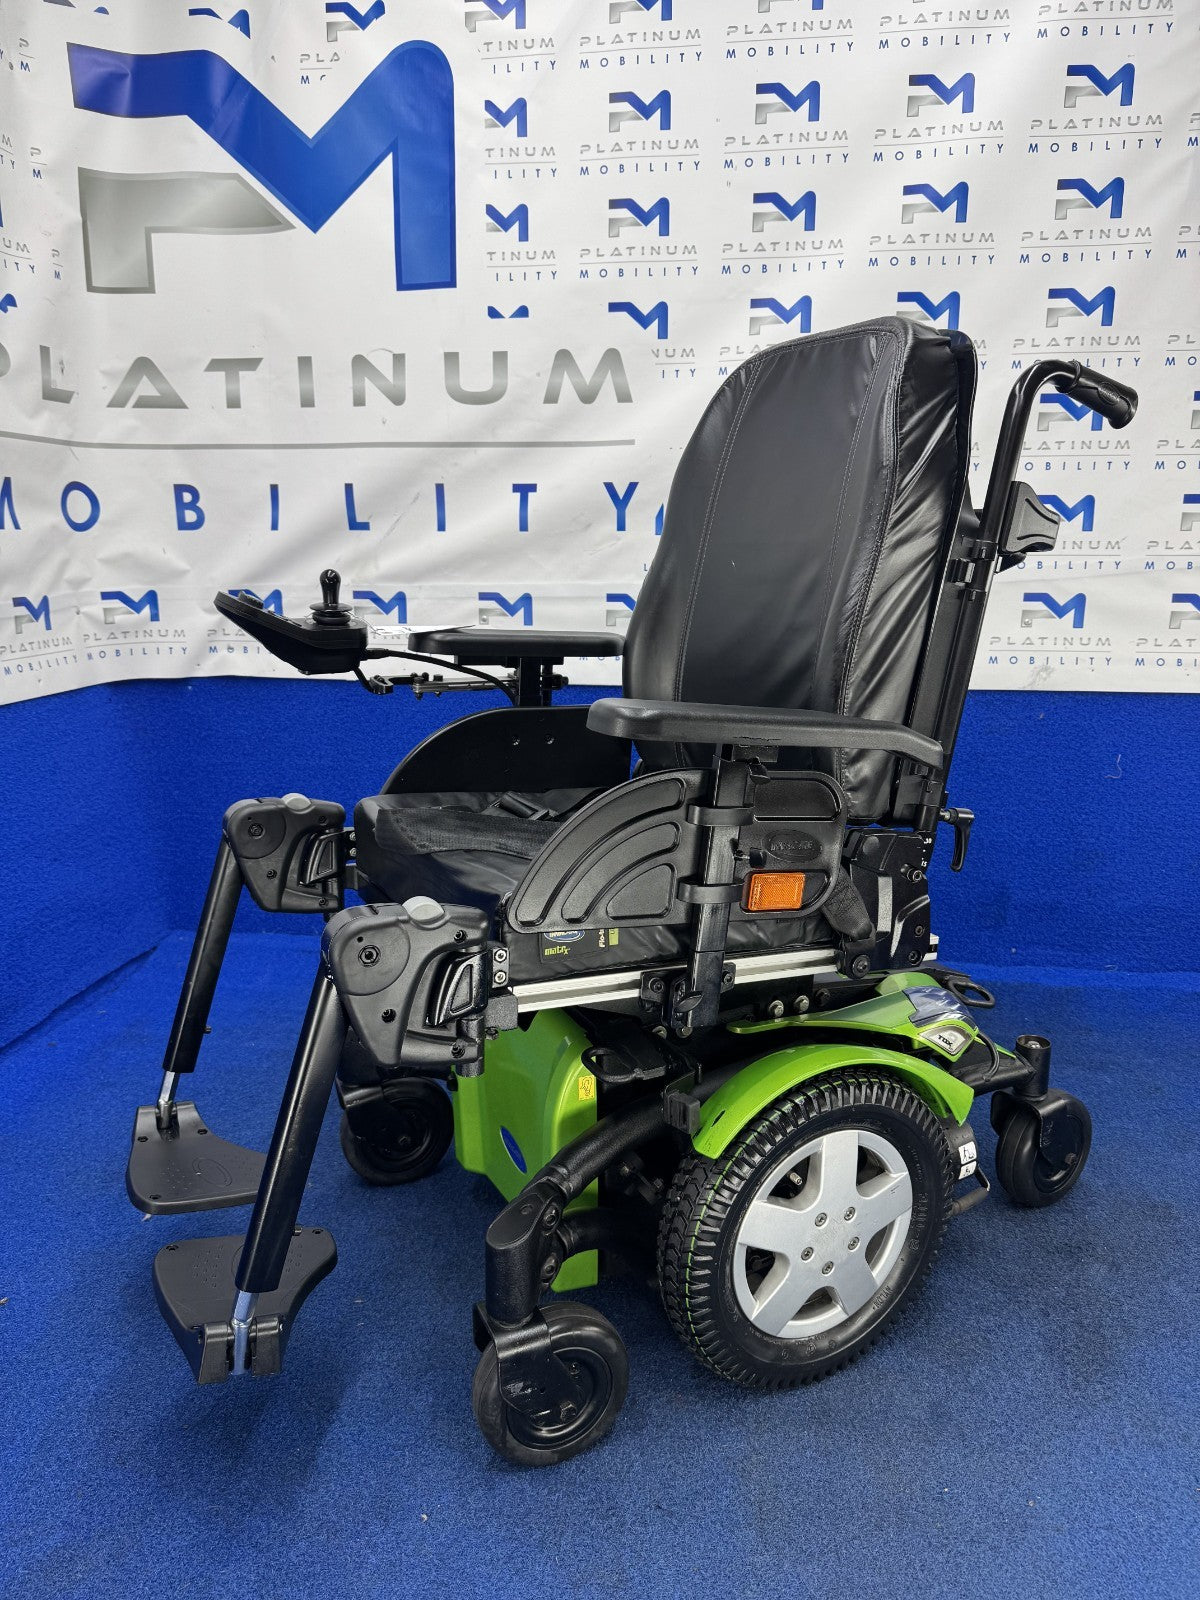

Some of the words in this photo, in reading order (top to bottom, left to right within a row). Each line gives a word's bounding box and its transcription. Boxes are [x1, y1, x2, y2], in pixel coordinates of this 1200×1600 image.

[1039, 0, 1175, 17] PLATINUM
[880, 9, 1010, 28] PLATINUM
[727, 19, 853, 38] PLATINUM
[1037, 21, 1174, 38] MOBILITY
[483, 37, 555, 54] TINUM
[580, 29, 701, 48] PLATINUM
[879, 31, 1010, 49] MOBILITY
[726, 41, 853, 58] MOBILITY
[491, 58, 556, 74] ILITY
[580, 51, 702, 69] MOBILITY
[874, 120, 1004, 141] PLATINUM
[1031, 115, 1163, 132] PLATINUM
[725, 130, 848, 148] PLATINUM
[1028, 138, 1162, 153] MOBILITY
[485, 147, 555, 158] TINUM
[580, 139, 699, 156] PLATINUM
[873, 142, 1003, 162] MOBILITY
[580, 160, 700, 176] MOBILITY
[724, 151, 849, 170] MOBILITY
[495, 168, 557, 179] ILITY
[870, 232, 994, 245] PLATINUM
[1022, 227, 1152, 243] PLATINUM
[580, 245, 697, 258] PLATINUM
[723, 239, 843, 255] PLATINUM
[487, 250, 555, 261] TINUM
[868, 255, 994, 267] MOBILITY
[1020, 249, 1152, 263] MOBILITY
[580, 266, 698, 278] MOBILITY
[721, 258, 844, 274] MOBILITY
[496, 271, 557, 281] ILITY
[1013, 336, 1140, 348] PLATINUM
[1021, 438, 1130, 451] LATINUM
[1024, 461, 1130, 471] OBILITY
[1017, 561, 1121, 569] OBILITY
[83, 628, 185, 644] PLATINUM
[990, 637, 1111, 646] PLATINUM
[86, 645, 187, 660] MOBILITY
[4, 655, 77, 675] MOBILITY
[988, 656, 1111, 667] MOBILITY
[937, 1034, 953, 1047] TDX
